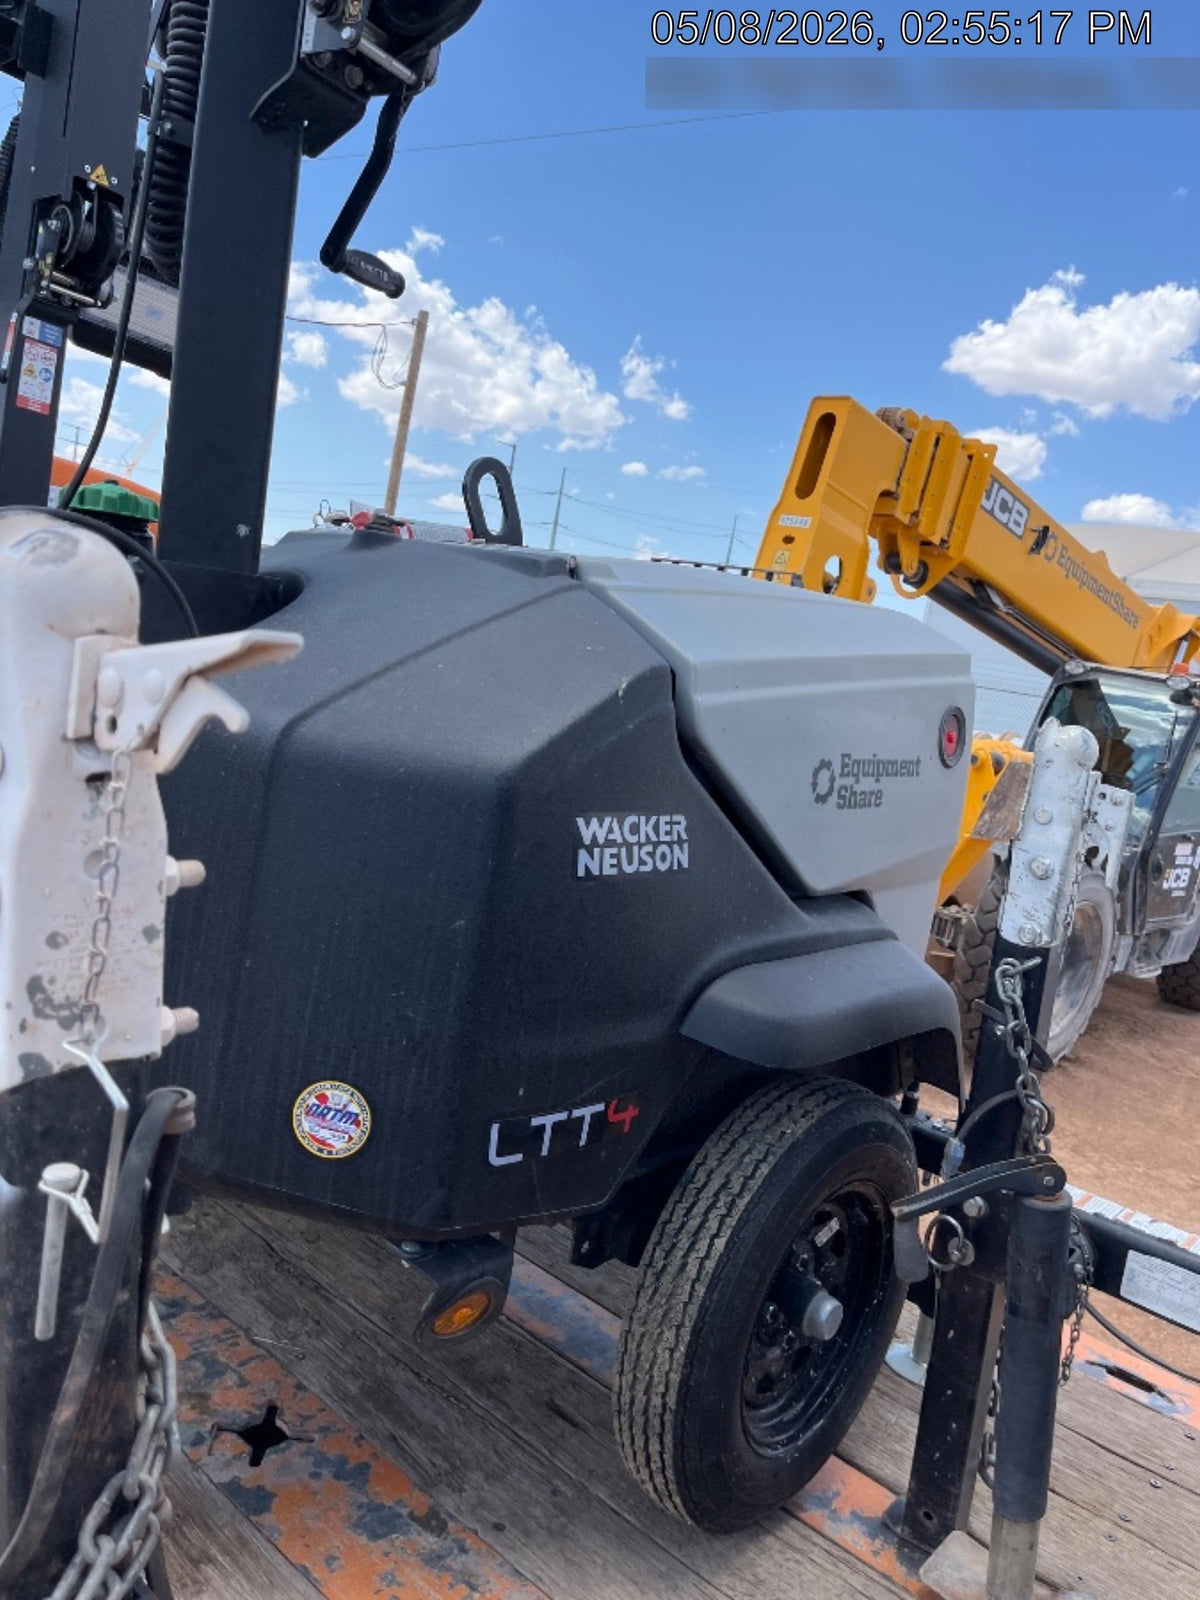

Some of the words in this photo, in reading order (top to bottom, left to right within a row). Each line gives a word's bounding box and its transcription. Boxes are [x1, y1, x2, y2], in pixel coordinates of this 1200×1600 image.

[981, 482, 1030, 537] JCB
[1056, 544, 1139, 629] EquipmentShare
[838, 753, 921, 783] Equipment
[836, 784, 883, 809] Share
[576, 813, 689, 845] WACKER
[576, 842, 689, 878] NEUSON
[1163, 867, 1191, 889] JCB
[488, 1098, 640, 1167] LTT4
